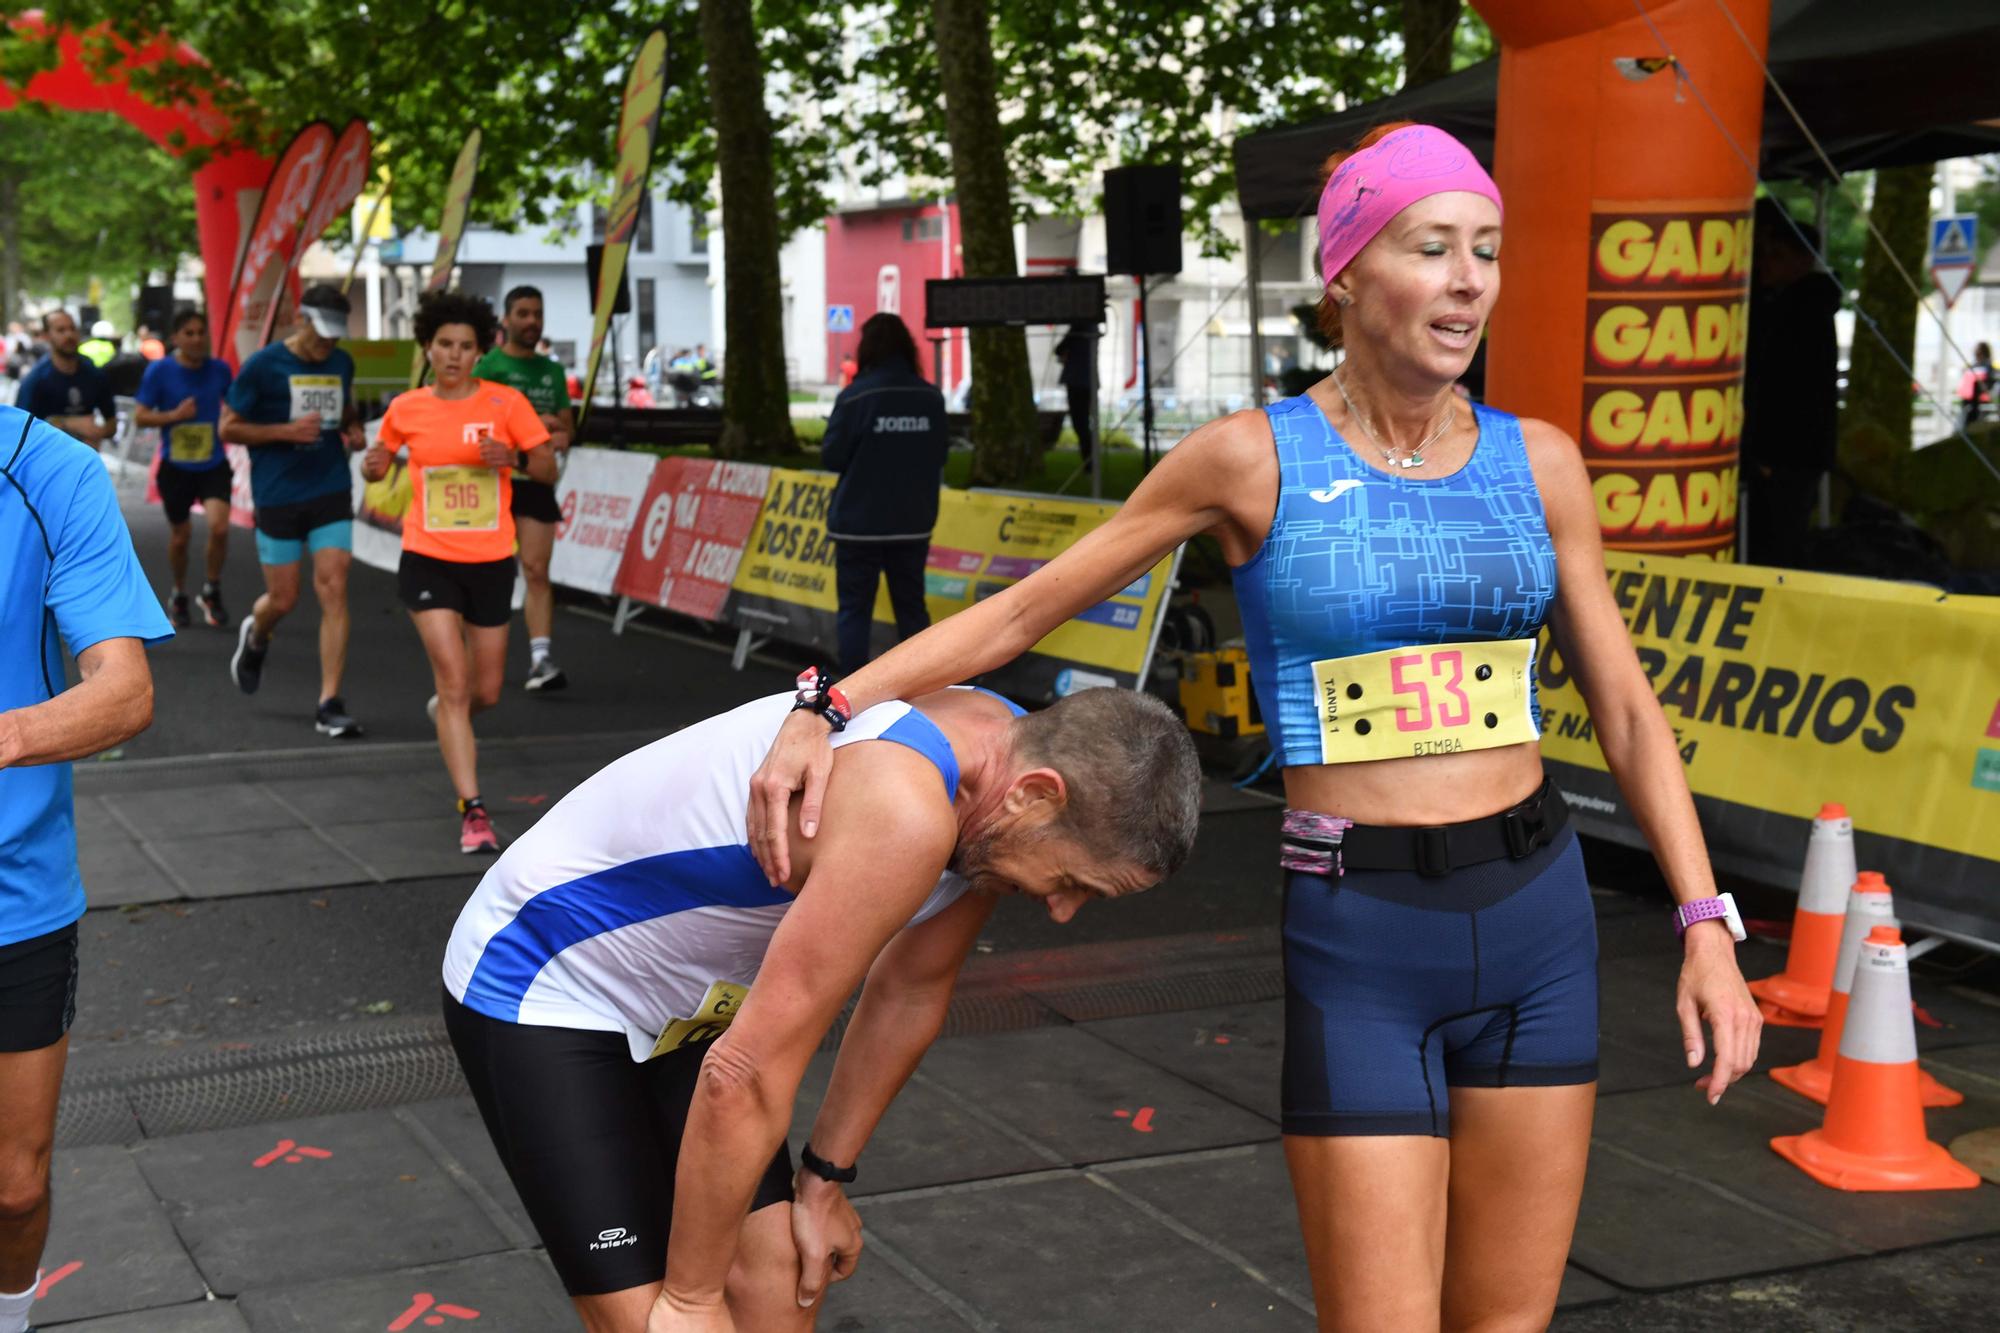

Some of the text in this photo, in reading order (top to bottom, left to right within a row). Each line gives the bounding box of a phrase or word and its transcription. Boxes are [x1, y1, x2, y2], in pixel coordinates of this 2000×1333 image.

[444, 483, 480, 509] 516
[766, 481, 833, 520] A XEN
[1604, 569, 1765, 650] ENTE
[1324, 678, 1338, 722] TANDA
[1389, 650, 1470, 732] 53
[1413, 738, 1464, 756] BIMBA
[589, 1234, 638, 1252] Kalenji
